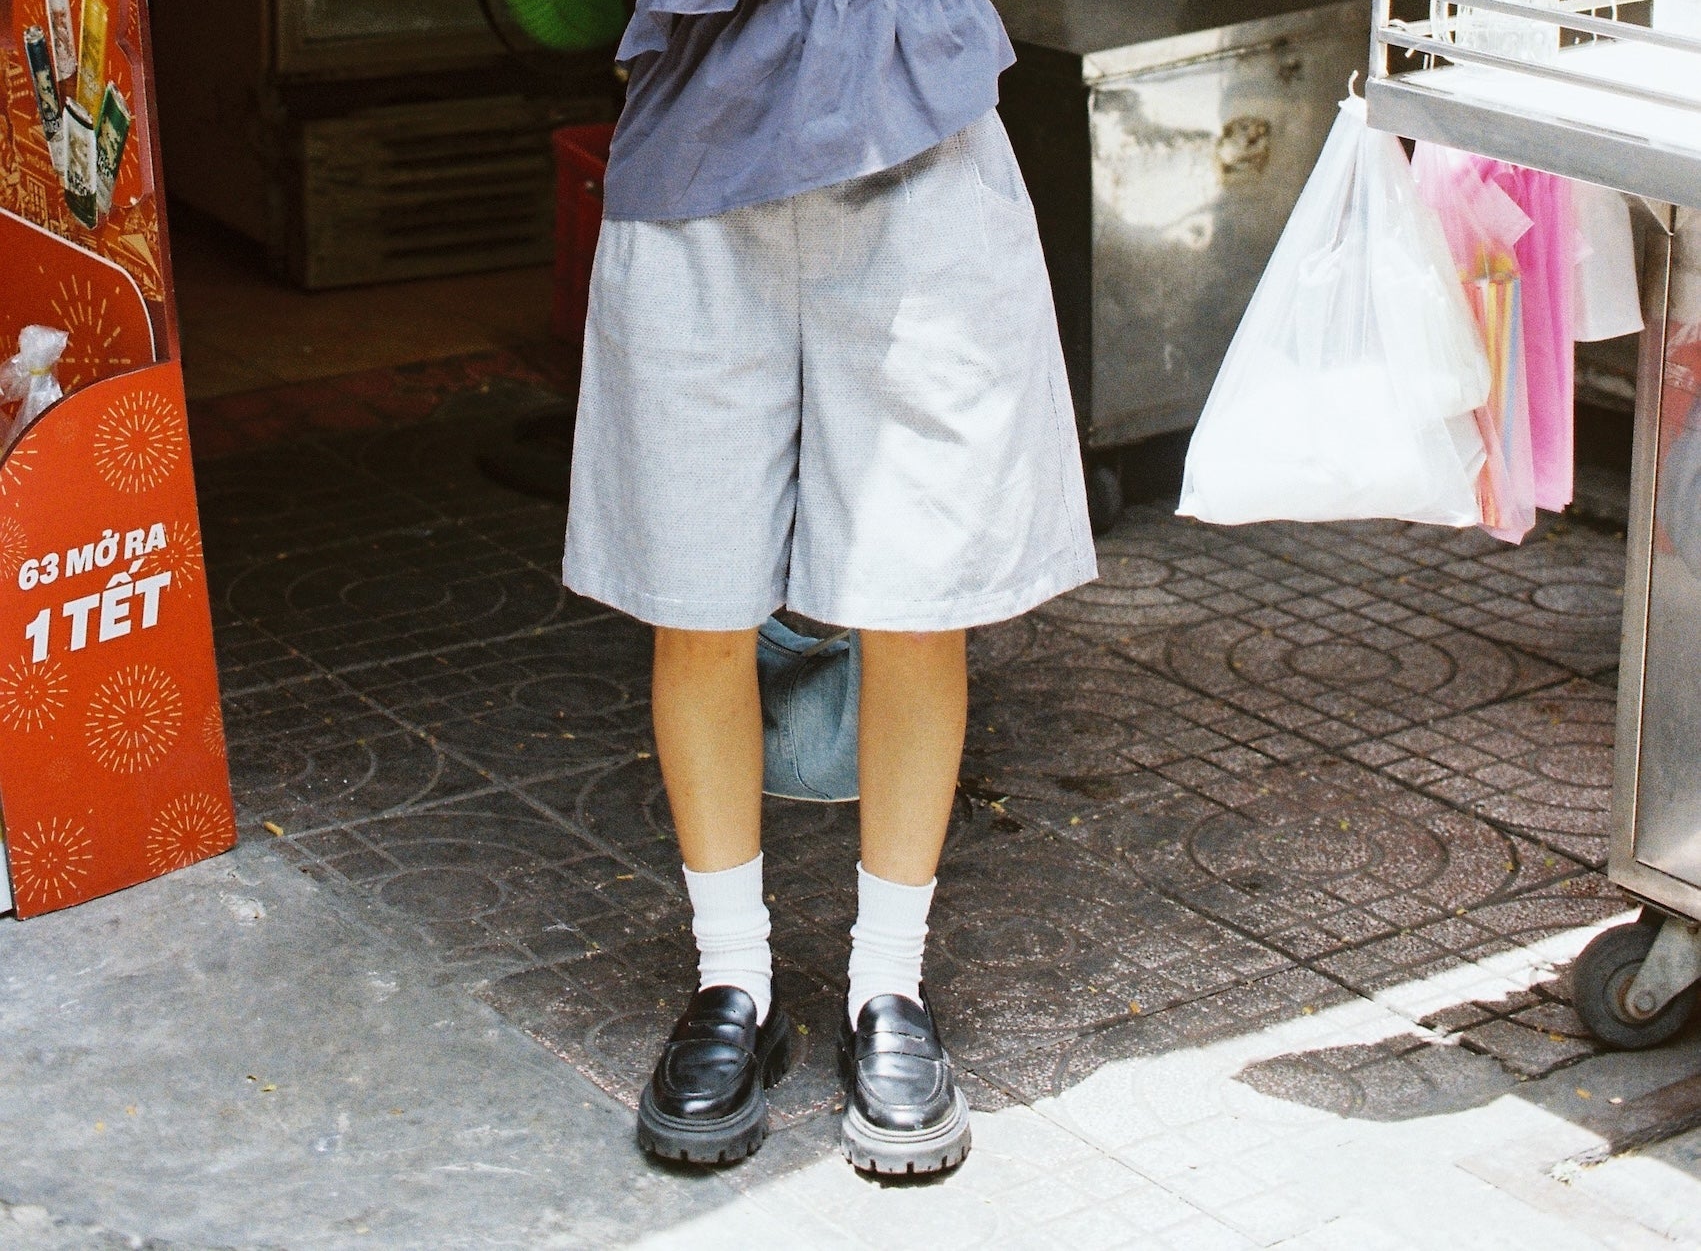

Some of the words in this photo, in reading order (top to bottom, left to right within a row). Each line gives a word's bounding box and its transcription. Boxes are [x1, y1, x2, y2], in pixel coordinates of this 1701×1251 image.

[18, 552, 60, 591] 63
[65, 528, 120, 578] MỞ
[124, 522, 168, 560] RA
[25, 608, 51, 664] 1
[62, 558, 172, 652] TẾT
